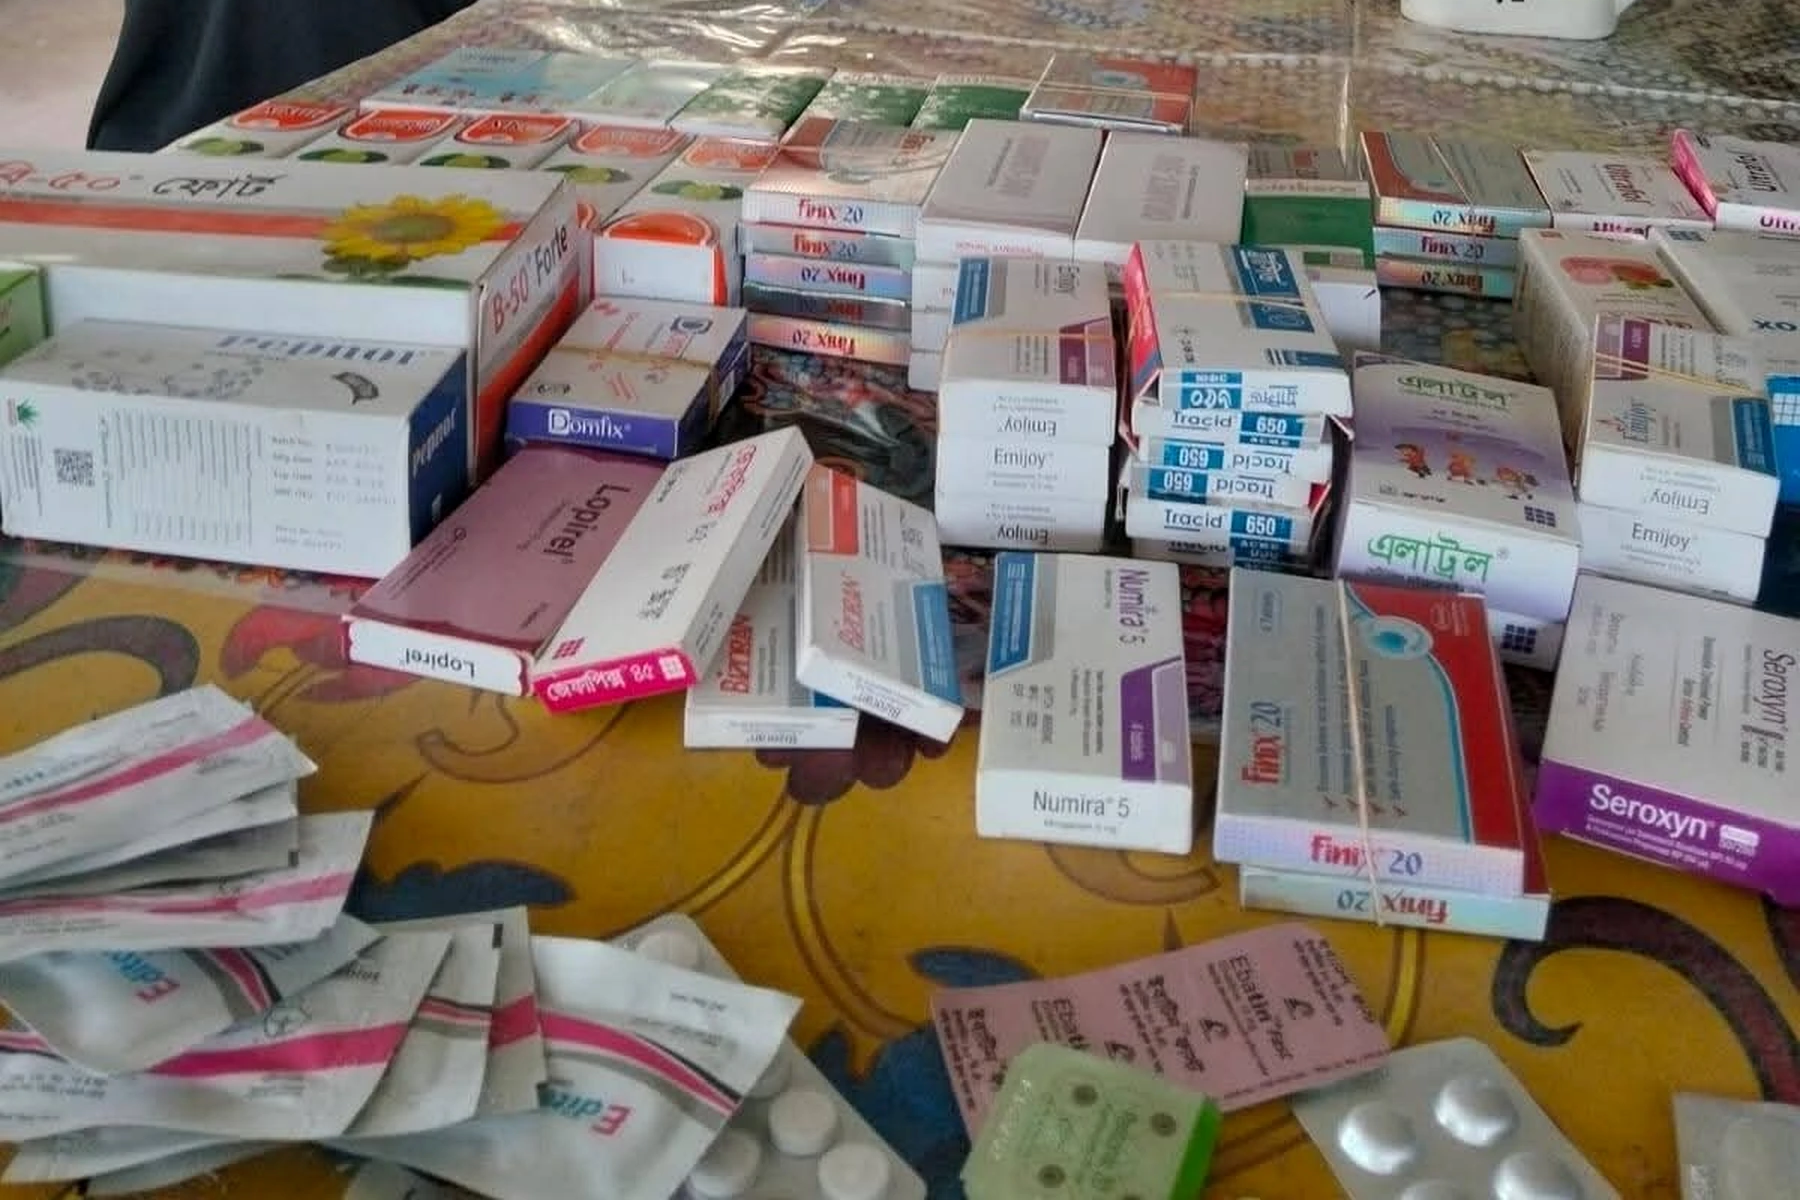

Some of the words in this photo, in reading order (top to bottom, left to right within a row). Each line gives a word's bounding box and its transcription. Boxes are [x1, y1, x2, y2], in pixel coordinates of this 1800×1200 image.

[843, 206, 864, 224] 20
[1760, 215, 1800, 231] Ultr
[534, 224, 568, 286] Forte
[801, 267, 820, 284] 20
[548, 408, 625, 440] Domfix
[1004, 416, 1057, 437] Emijoy
[1172, 411, 1233, 429] Tracid
[1256, 416, 1287, 435] 650
[994, 447, 1047, 469] Emijoy
[1178, 449, 1209, 469] 650
[1232, 453, 1291, 474] Tracid
[1163, 471, 1193, 491] 650
[1214, 477, 1275, 499] Tracid
[1651, 488, 1711, 515] Emijoy
[543, 483, 632, 557] Lopirel
[1165, 508, 1223, 529] Tracid
[1246, 514, 1277, 536] 650
[997, 523, 1049, 545] Emijoy
[1631, 522, 1692, 551] Emijoy
[404, 645, 477, 680] Lopirel
[1754, 648, 1796, 730] Seroxyn
[1252, 700, 1282, 728] 20
[1032, 789, 1106, 817] Numira
[1117, 798, 1131, 819] 5
[1590, 783, 1708, 840] Seroxyn
[1389, 849, 1423, 876] 20
[1337, 889, 1370, 912] 20
[1382, 889, 1448, 924] Finix
[1229, 954, 1274, 1023] Ebatin
